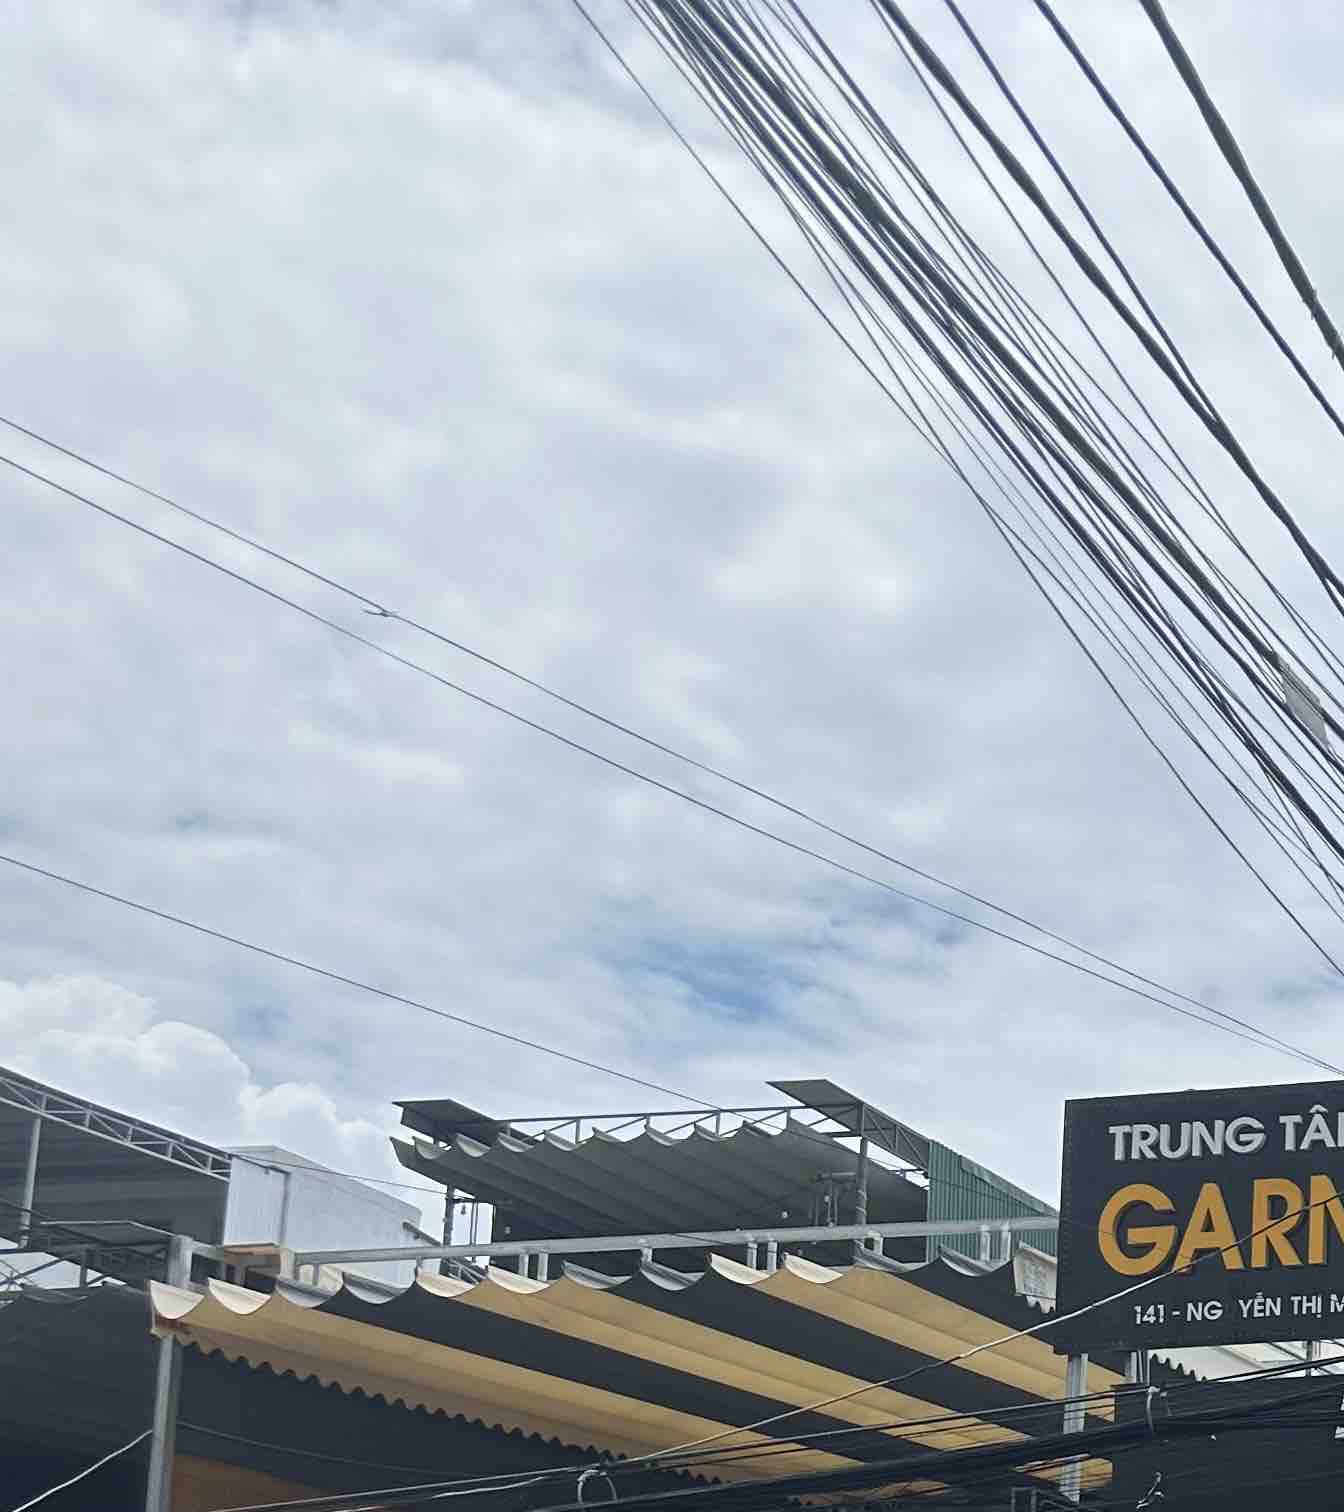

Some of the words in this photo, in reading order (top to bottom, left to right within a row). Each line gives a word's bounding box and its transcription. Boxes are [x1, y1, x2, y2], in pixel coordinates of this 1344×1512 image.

[1109, 1117, 1266, 1161] TRUNG
[1134, 1304, 1165, 1325] 141
[1290, 1295, 1322, 1319] THỊ
